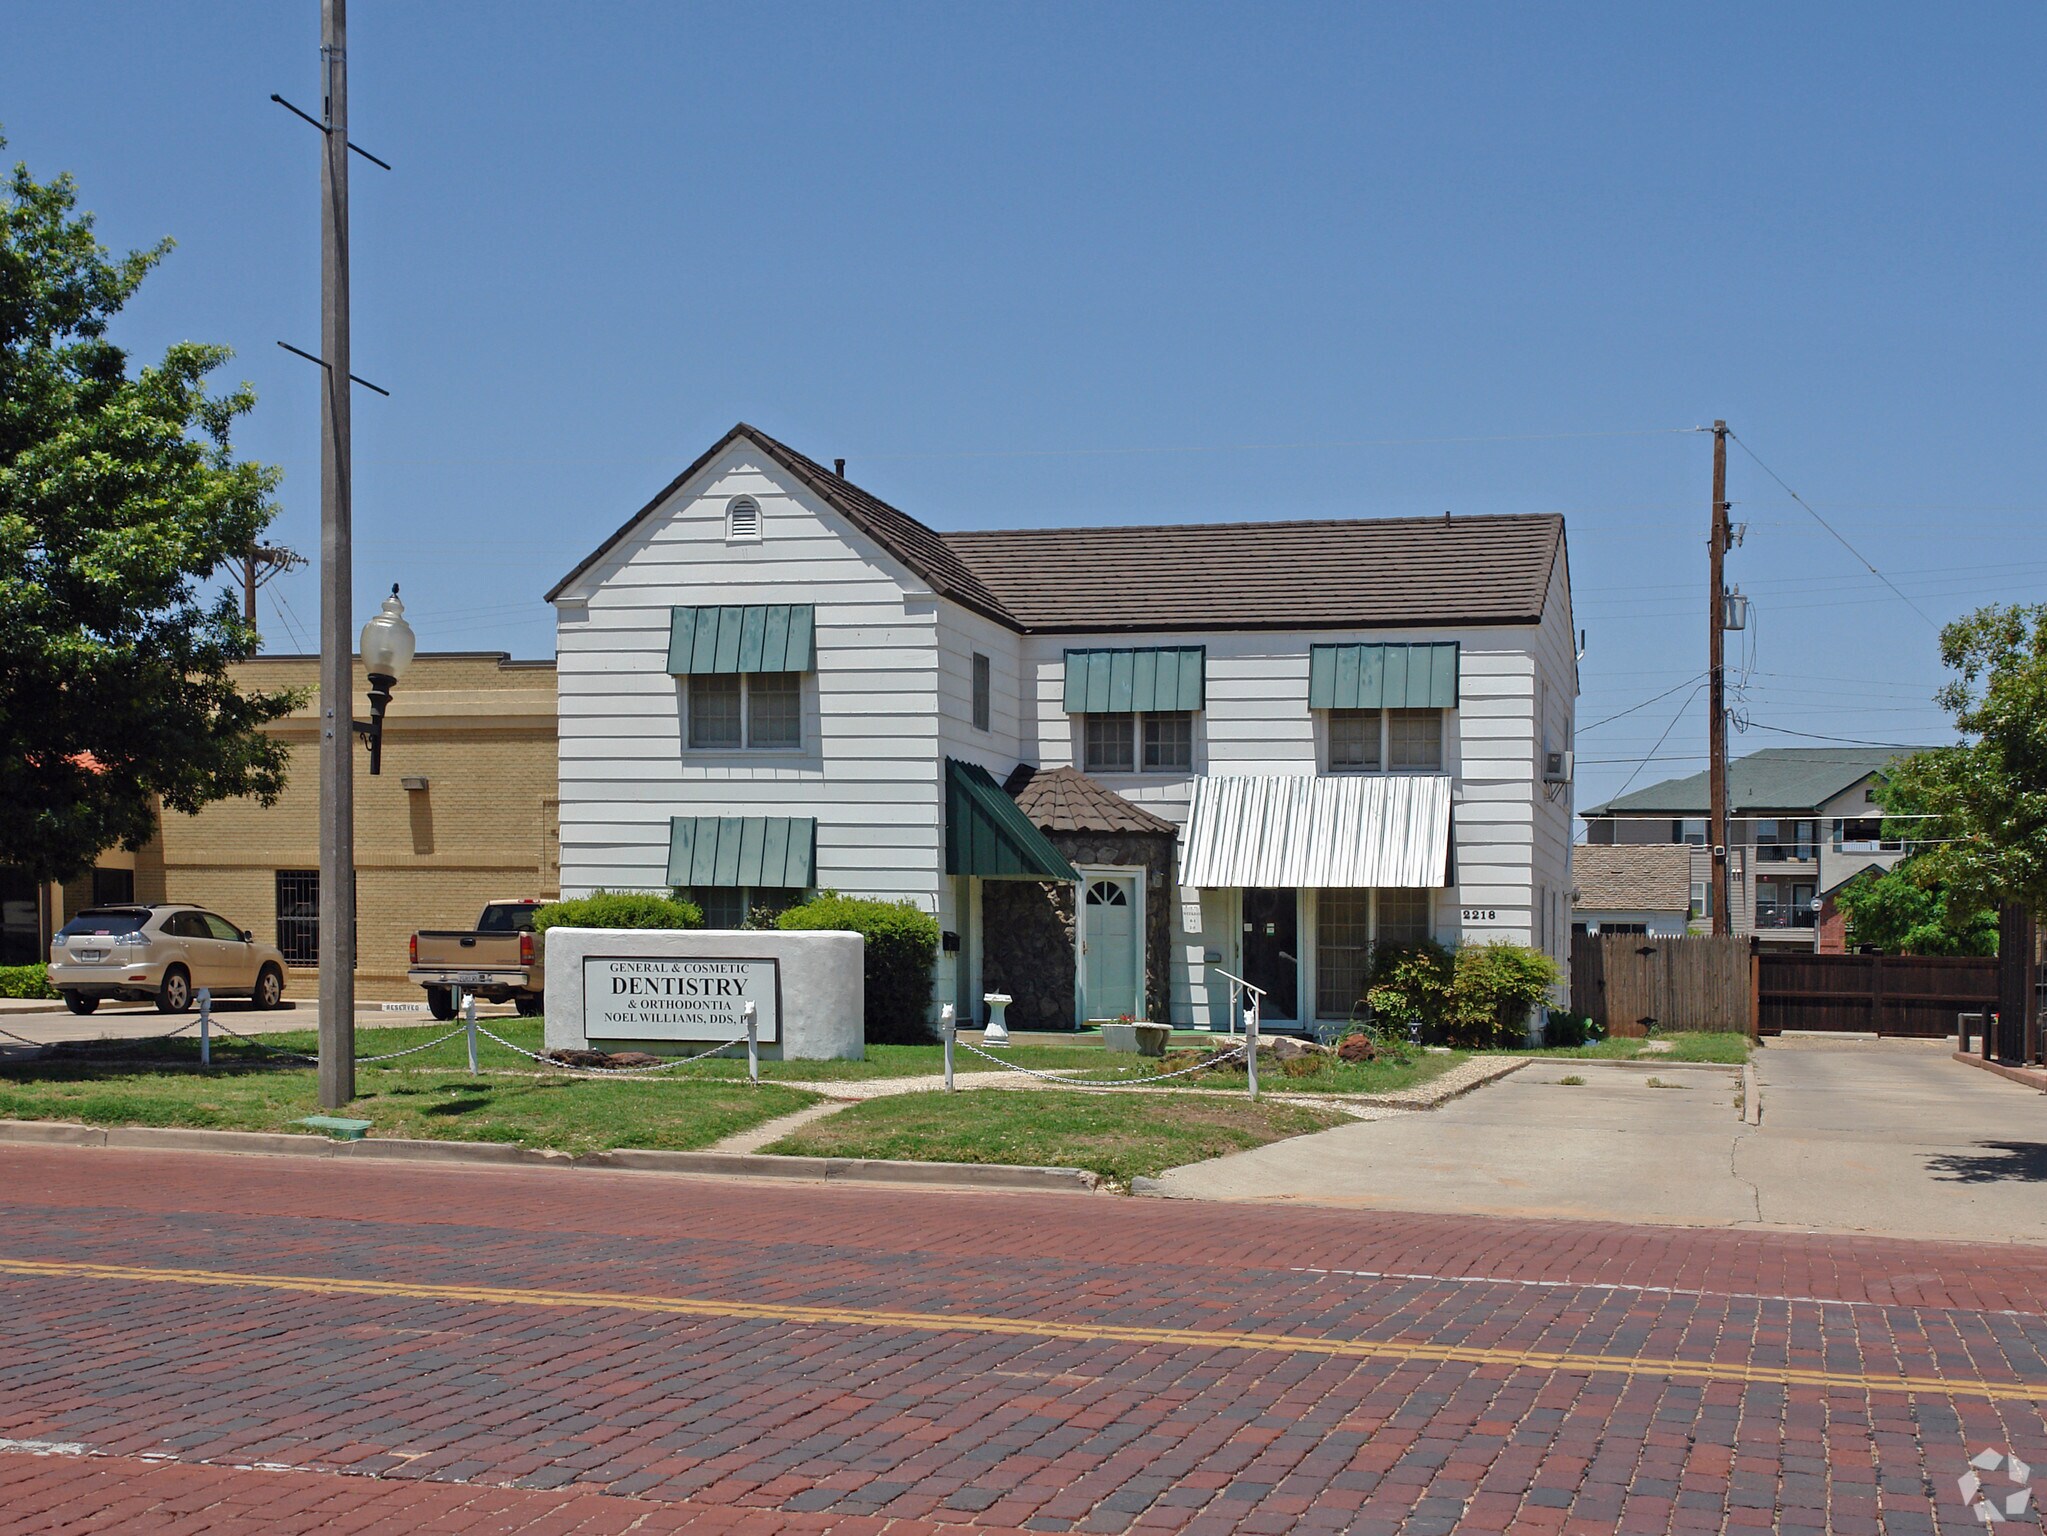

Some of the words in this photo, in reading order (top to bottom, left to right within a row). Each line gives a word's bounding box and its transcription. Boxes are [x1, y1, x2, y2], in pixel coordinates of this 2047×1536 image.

[1463, 910, 1496, 920] 2218
[609, 962, 668, 974] GENERAL
[671, 963, 681, 974] &
[684, 963, 750, 975] COSMETIC
[611, 976, 749, 996] DENTISTRY
[627, 999, 637, 1010] &
[640, 1000, 732, 1011] ORTHODONTIA
[604, 1012, 638, 1023] NOEL
[639, 1013, 707, 1025] WILLIAMS,
[709, 1014, 737, 1026] DDS,
